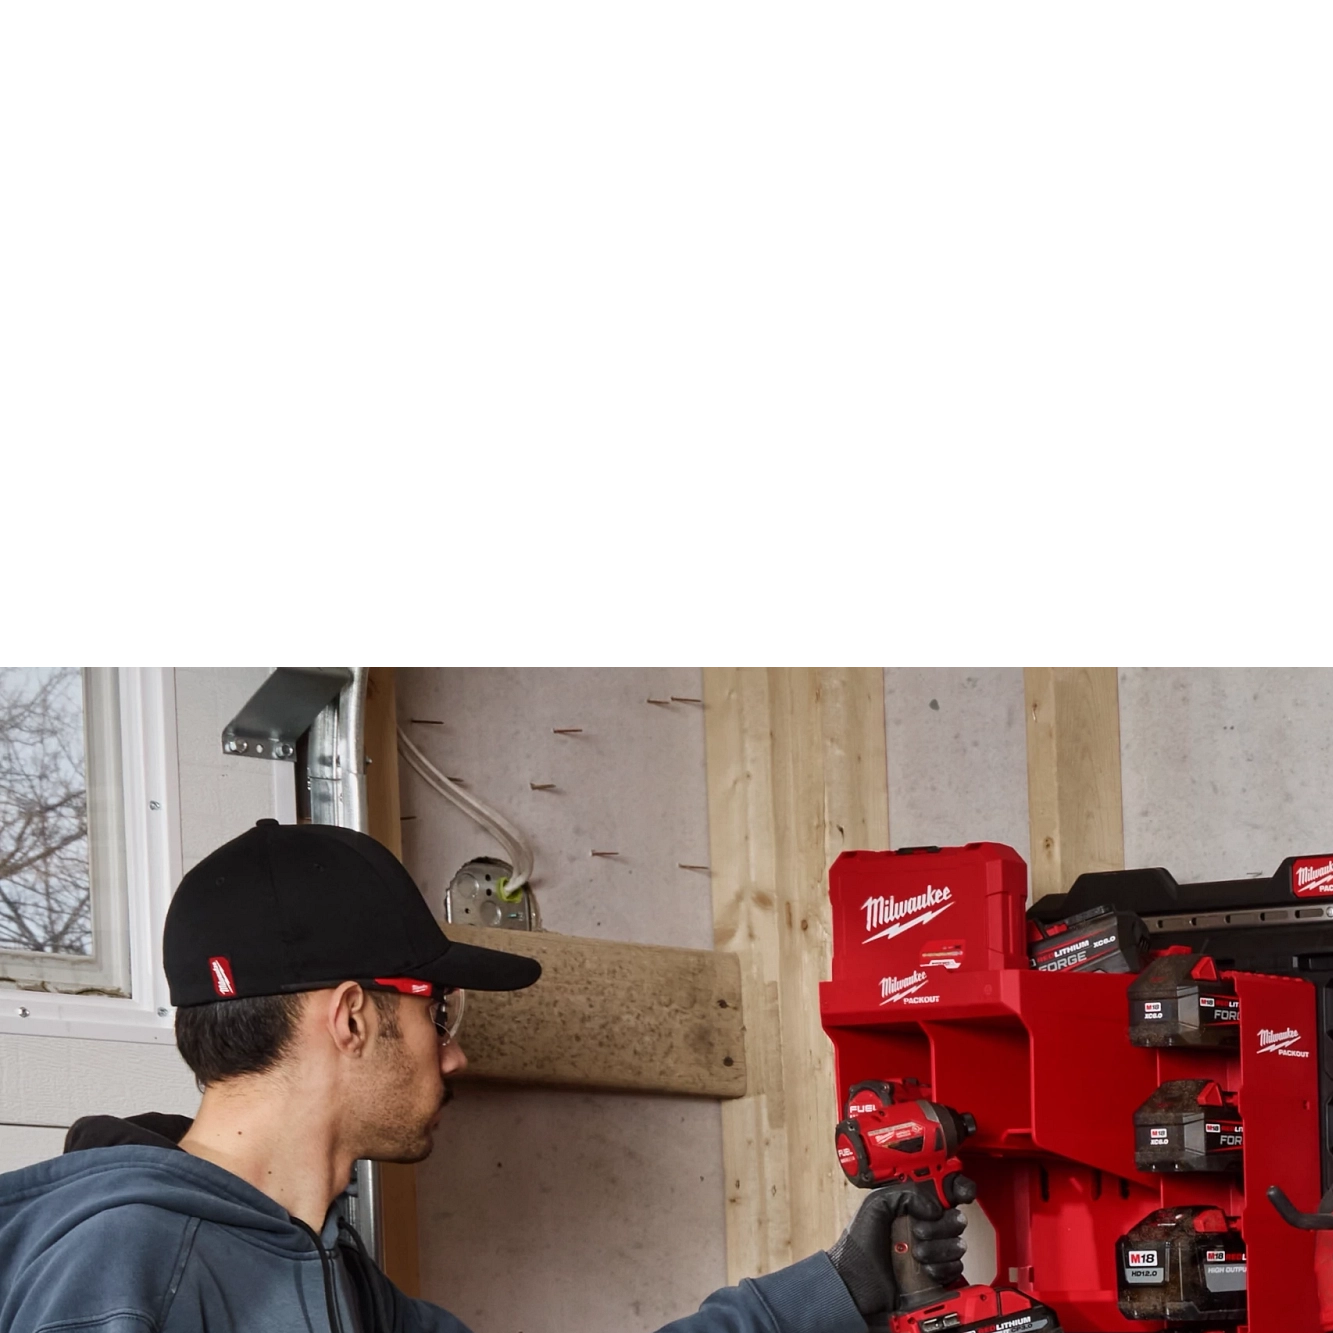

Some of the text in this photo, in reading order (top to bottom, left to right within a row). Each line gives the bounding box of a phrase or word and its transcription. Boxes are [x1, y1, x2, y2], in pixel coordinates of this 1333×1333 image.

[860, 884, 952, 932] Milwaukee
[878, 970, 928, 998] Milwaukee
[903, 995, 940, 1005] PACKOUT
[1256, 1027, 1299, 1047] Milwaukee
[1278, 1049, 1310, 1058] PACKOUT
[1130, 1253, 1155, 1264] M18
